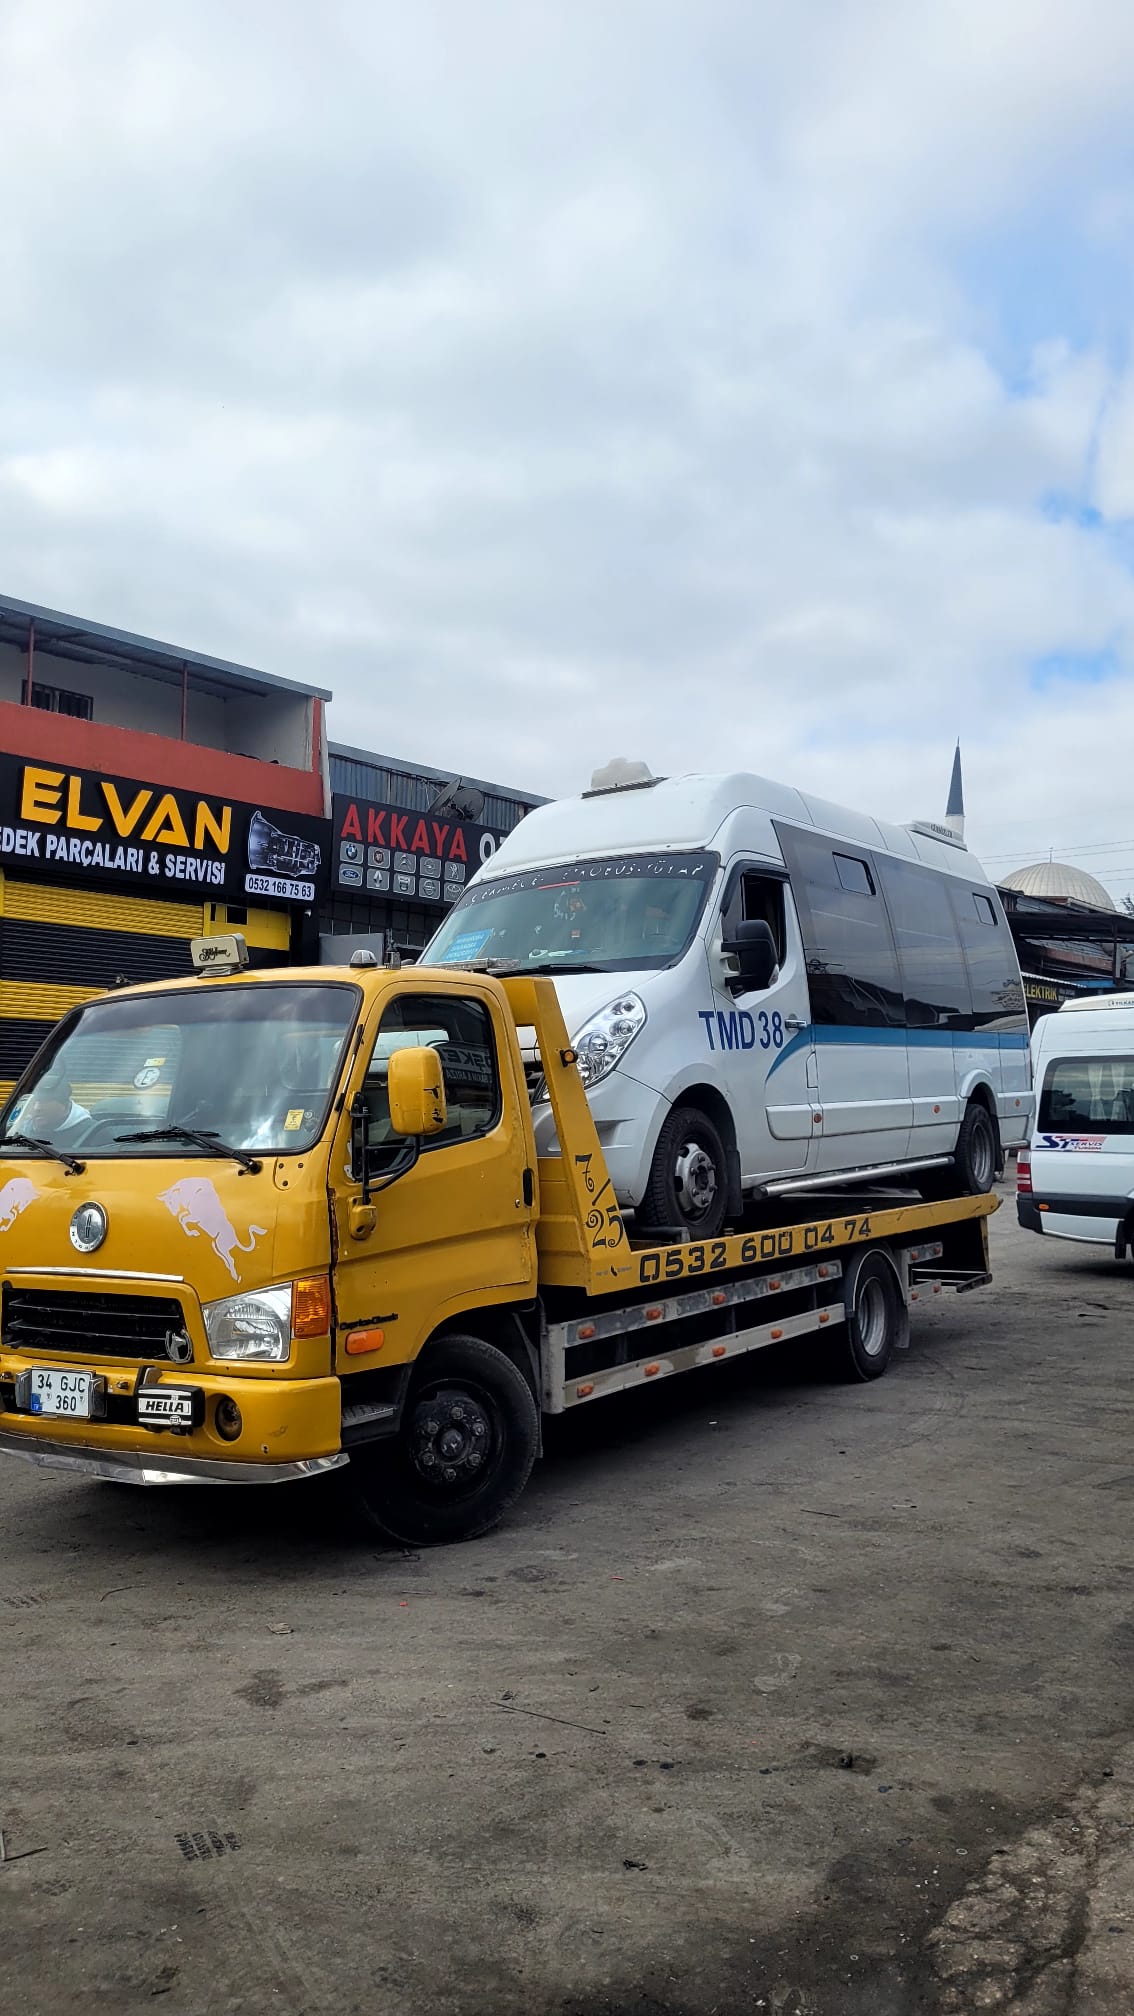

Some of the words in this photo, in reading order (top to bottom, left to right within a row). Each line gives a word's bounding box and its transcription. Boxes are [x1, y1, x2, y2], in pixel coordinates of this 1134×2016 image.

[20, 765, 232, 854] ELVAN
[0, 826, 41, 857] DEK
[45, 834, 144, 873] PARÇALARI
[148, 851, 160, 875] &
[340, 803, 468, 862] AKKAYA
[479, 832, 508, 864] O
[248, 877, 270, 892] 0532
[272, 880, 287, 895] 166
[289, 883, 299, 896] 75
[301, 885, 312, 898] 63
[640, 1242, 727, 1283] 0532
[741, 1231, 793, 1263] 600
[804, 1223, 835, 1250] 04
[844, 1217, 871, 1241] 74
[37, 1373, 52, 1390] 34
[60, 1375, 86, 1393] GJC
[55, 1394, 77, 1412] 360
[145, 1400, 184, 1413] HELLA
